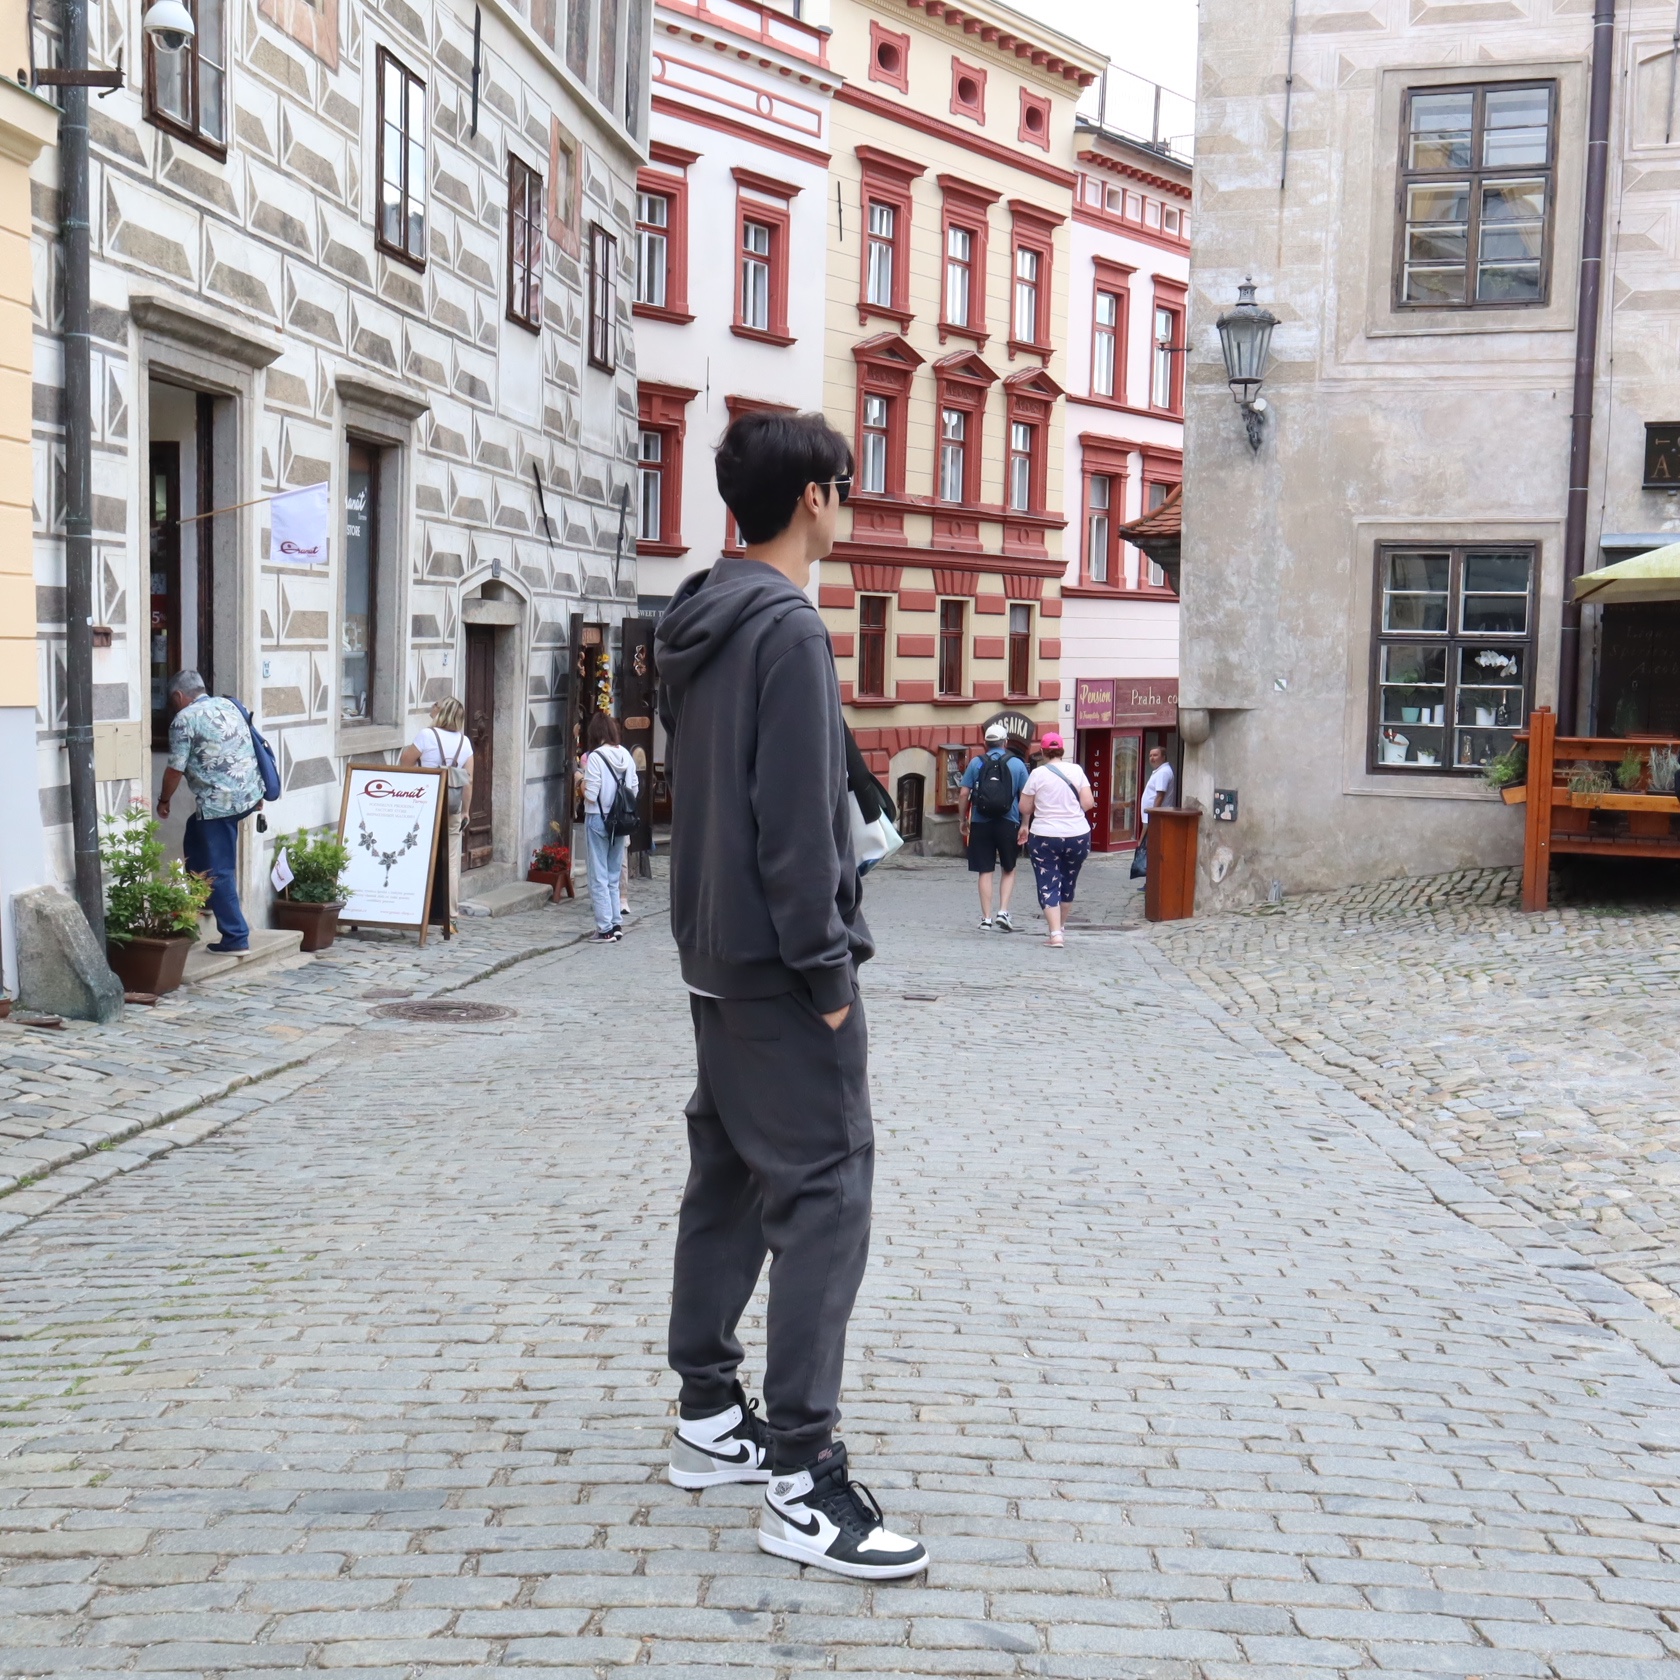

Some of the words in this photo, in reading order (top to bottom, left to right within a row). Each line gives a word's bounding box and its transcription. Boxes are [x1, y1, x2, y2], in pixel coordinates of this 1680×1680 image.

[638, 609, 657, 617] SWEET
[1080, 684, 1112, 705] Pension
[1131, 687, 1161, 706] Praha
[991, 717, 1028, 739] SAIKA
[1091, 749, 1100, 830] Jewellery
